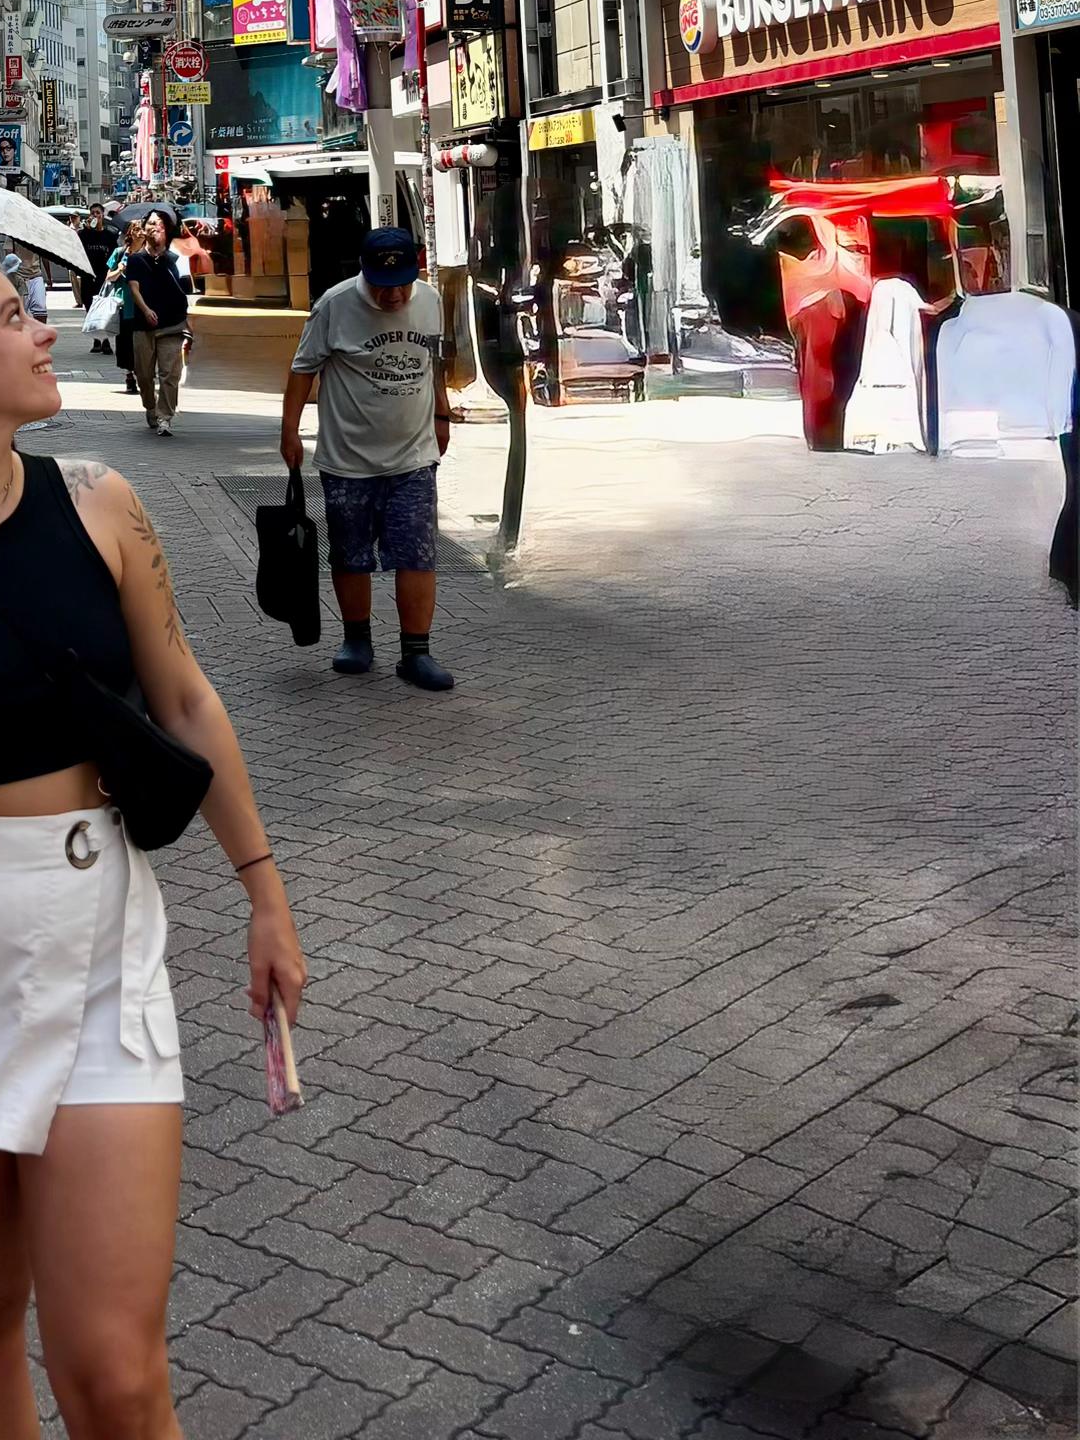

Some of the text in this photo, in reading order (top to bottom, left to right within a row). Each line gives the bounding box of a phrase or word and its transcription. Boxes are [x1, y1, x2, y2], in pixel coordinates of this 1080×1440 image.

[107, 17, 173, 30] 渋谷センター街
[174, 56, 201, 69] 消火栓
[363, 330, 430, 353] SUPER CUB
